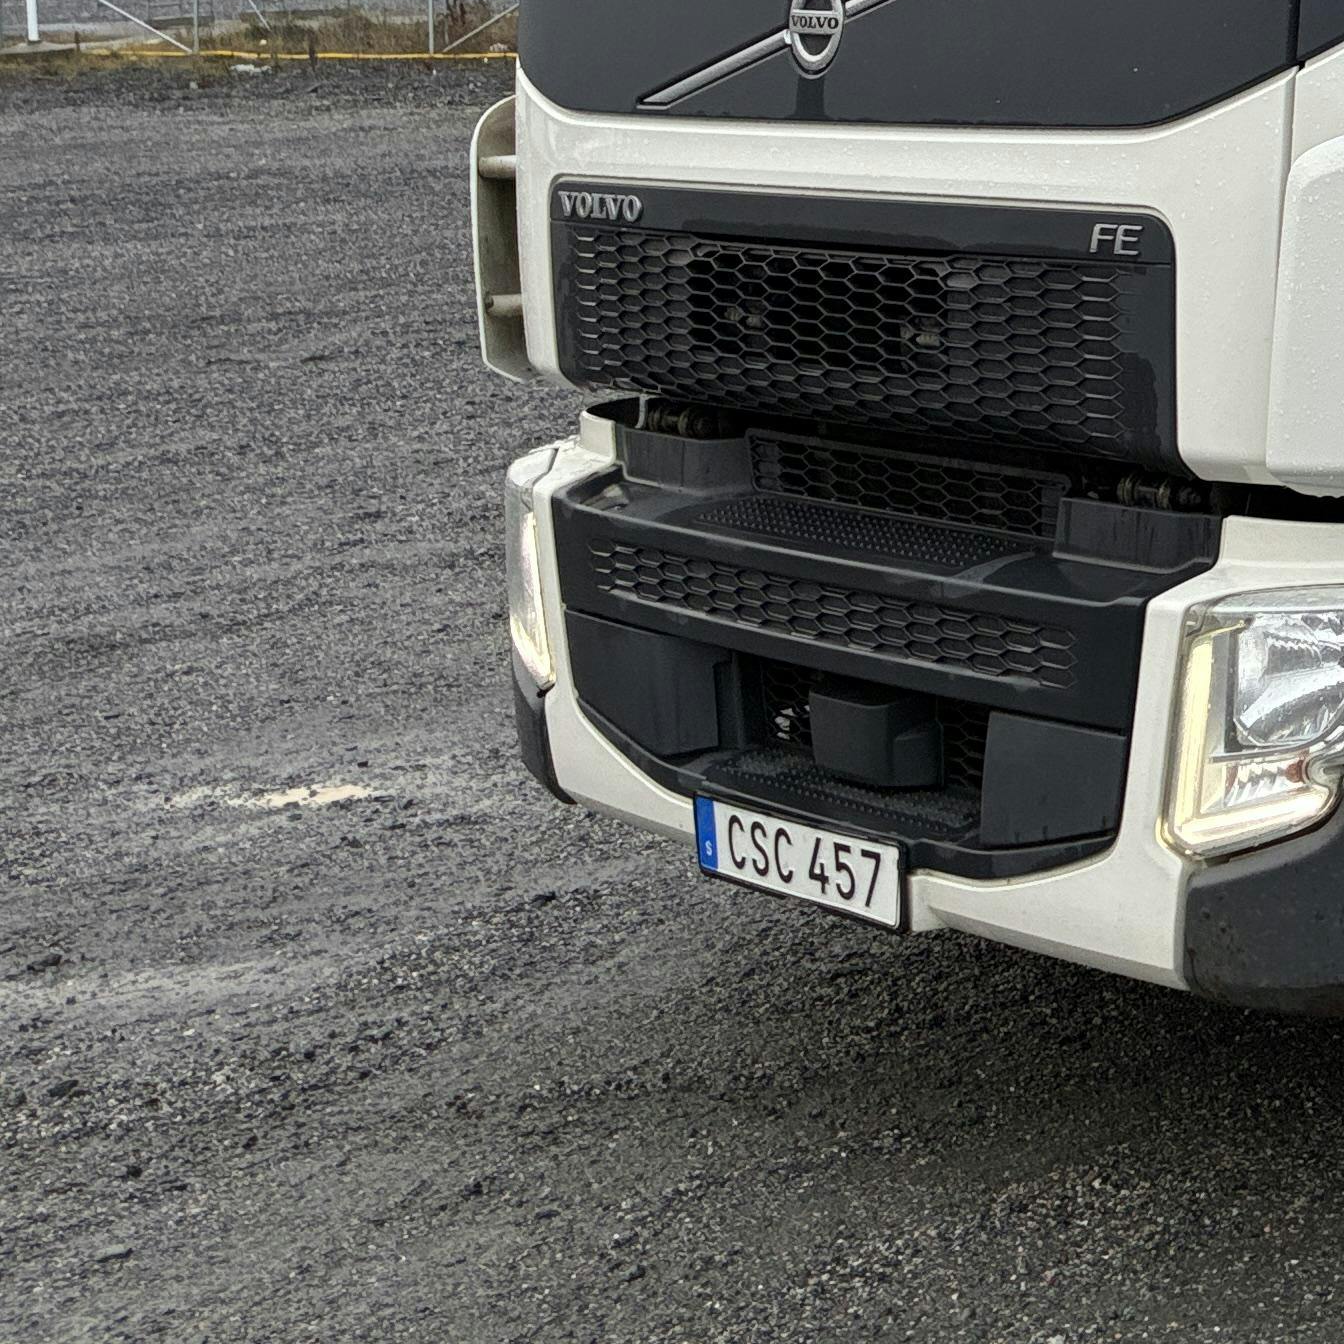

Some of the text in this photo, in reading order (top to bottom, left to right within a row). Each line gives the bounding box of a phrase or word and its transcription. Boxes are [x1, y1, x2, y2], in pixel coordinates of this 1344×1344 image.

[791, 15, 839, 29] VOLVO
[558, 190, 642, 222] VOLVO
[1090, 223, 1143, 256] FE
[706, 814, 881, 907] S CSC 457
